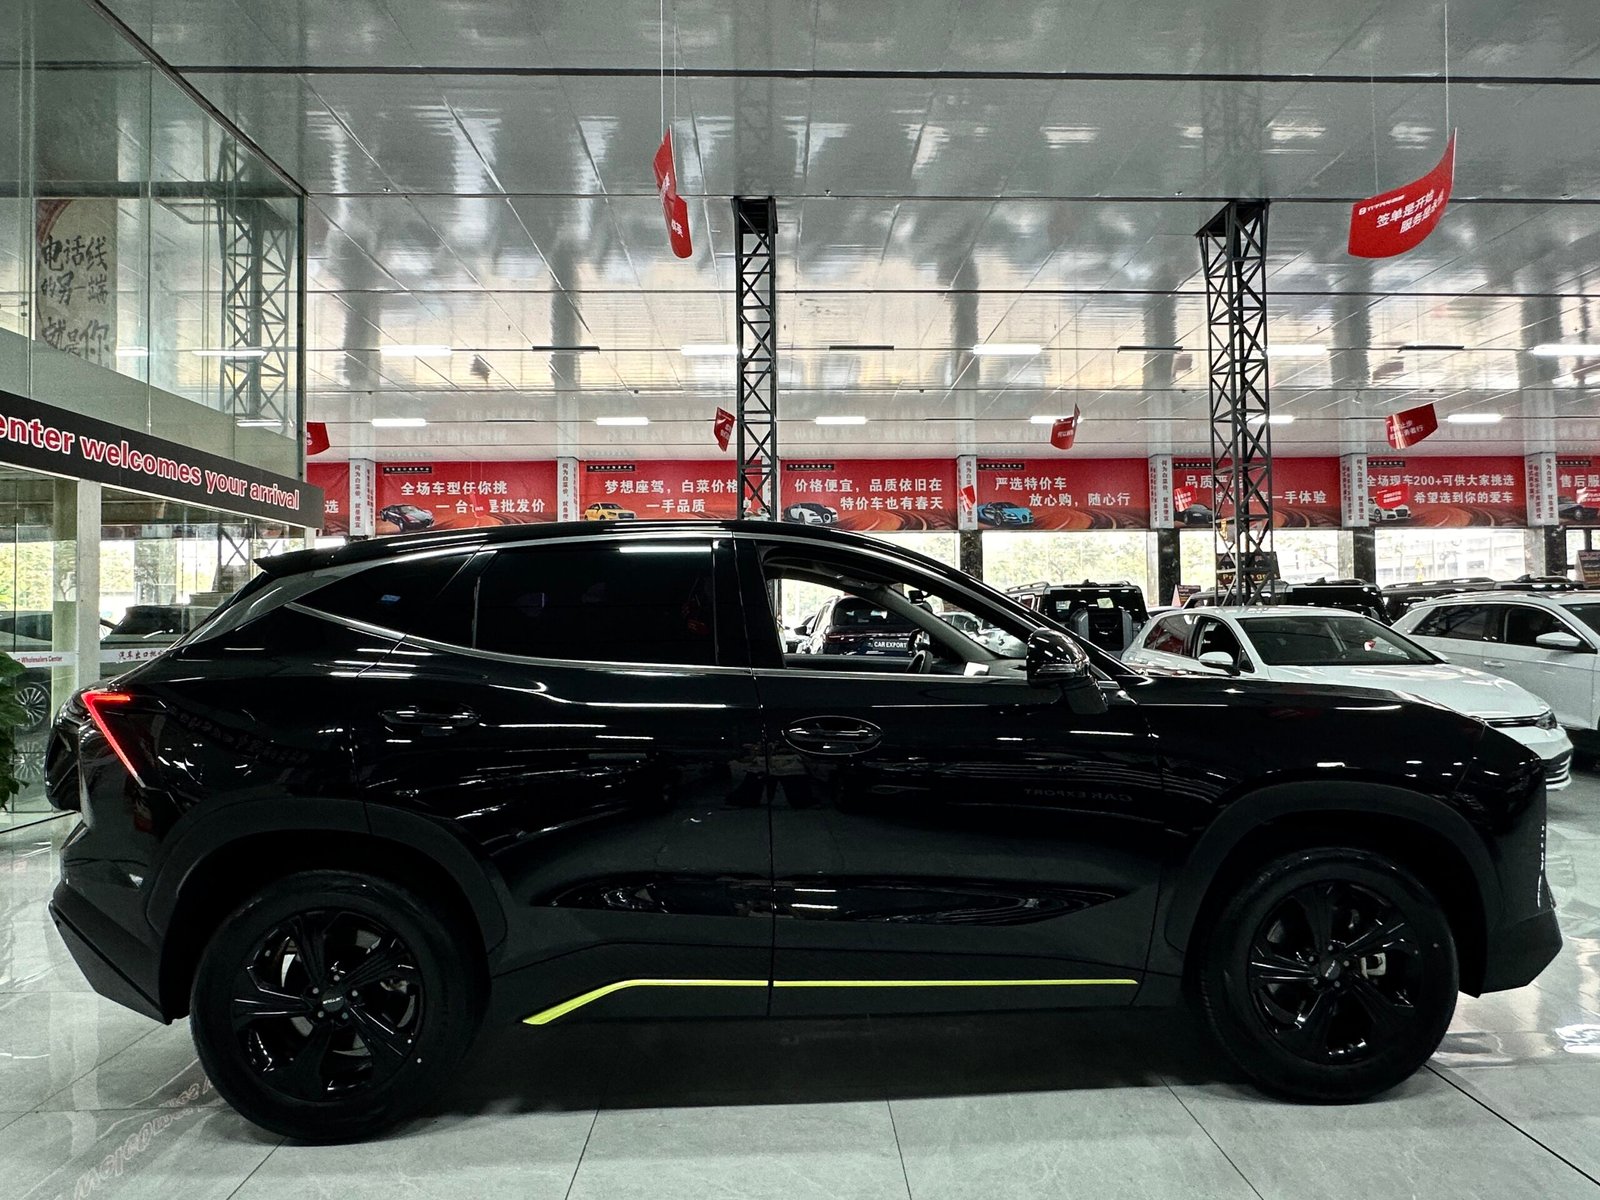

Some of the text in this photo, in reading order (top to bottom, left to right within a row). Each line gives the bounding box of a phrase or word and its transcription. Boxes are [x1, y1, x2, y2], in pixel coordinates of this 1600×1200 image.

[41, 235, 107, 271] 电话线
[79, 434, 202, 486] welcomes
[204, 468, 249, 494] your
[250, 481, 300, 511] arrival
[794, 478, 943, 493] 价格便宜，品质依旧在
[995, 476, 1067, 491] 严选特价车
[1367, 474, 1515, 487] 全场现车200+可供大家挑选
[401, 481, 508, 496] 全场车型任你挑
[840, 497, 944, 511] 特价车也有春天
[1029, 493, 1131, 507] 放心购，随心行
[1414, 492, 1513, 504] 希望选到你的爱车
[324, 500, 339, 514] 选
[436, 499, 545, 514] 一台是批发价
[646, 499, 706, 513] 一手品质
